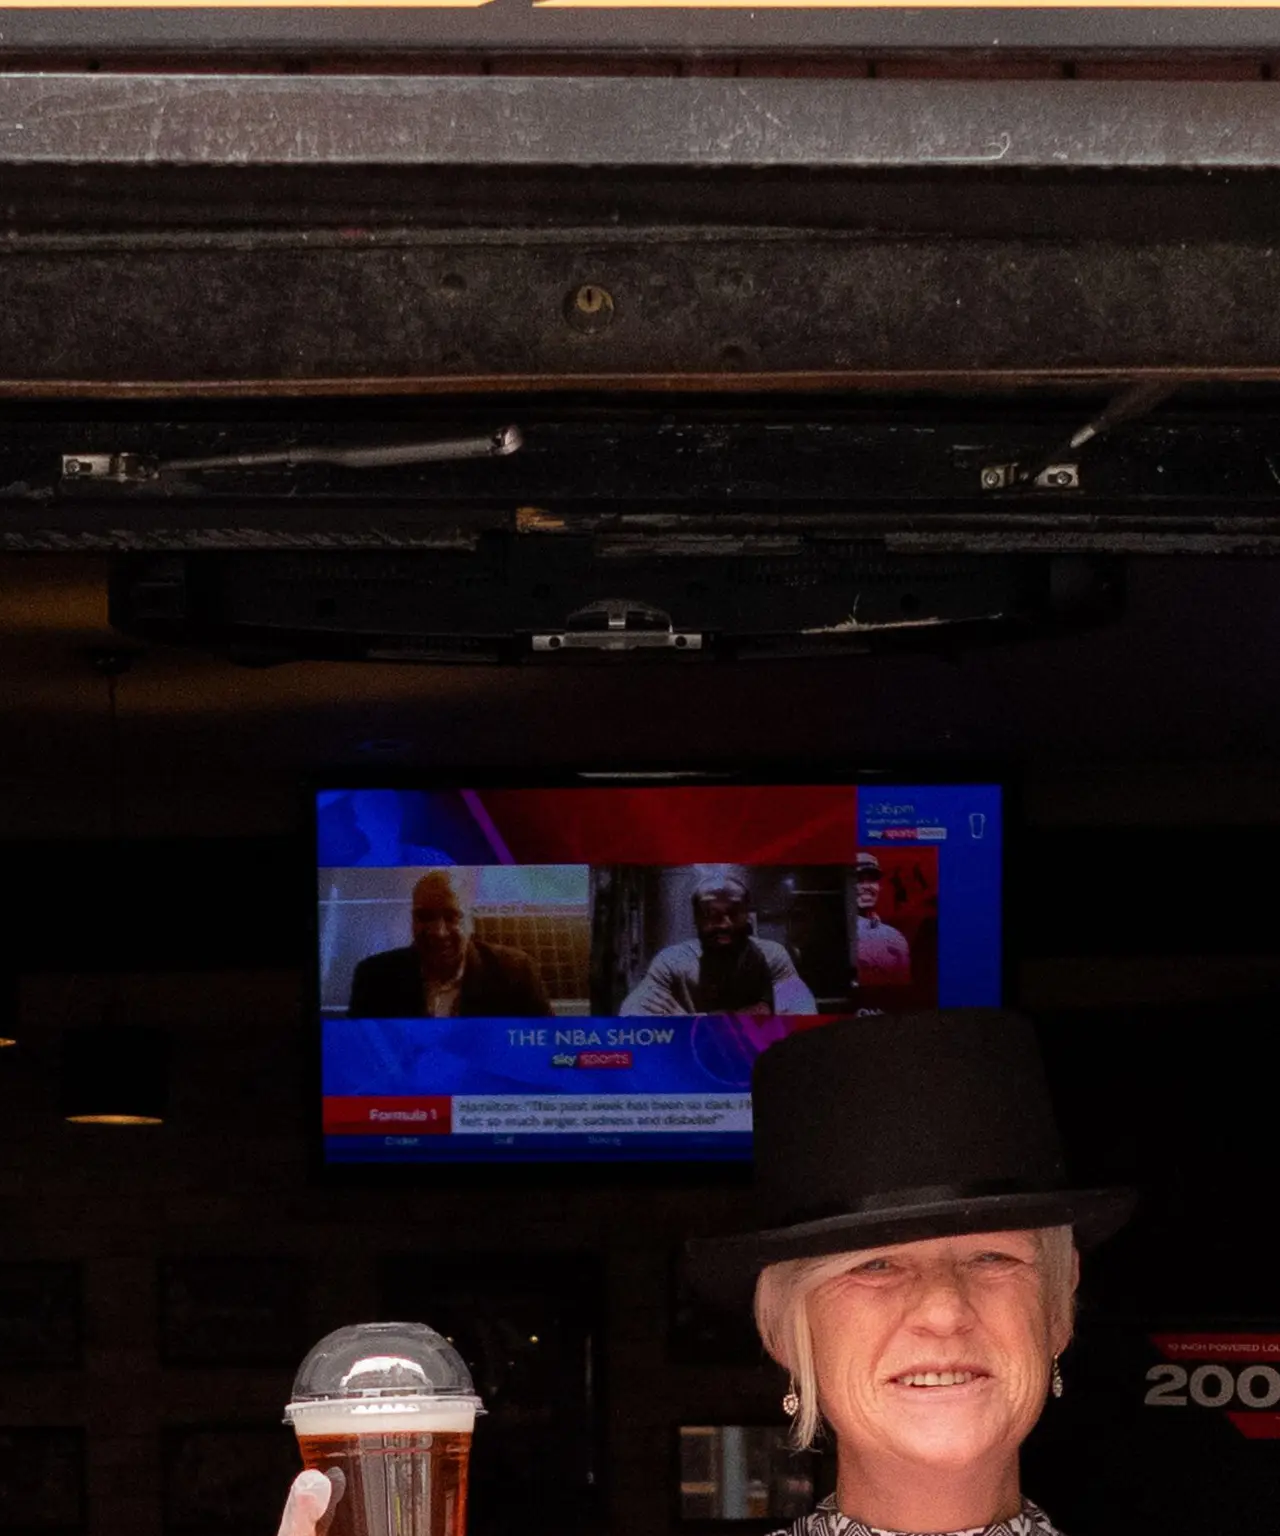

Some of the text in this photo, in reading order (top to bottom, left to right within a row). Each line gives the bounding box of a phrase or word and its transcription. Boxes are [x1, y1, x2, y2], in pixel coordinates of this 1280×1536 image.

[508, 1028, 675, 1046] THE NBA SHOW
[552, 1052, 629, 1067] sky sports
[369, 1108, 438, 1122] Formula 1
[1209, 1343, 1260, 1353] POWERED
